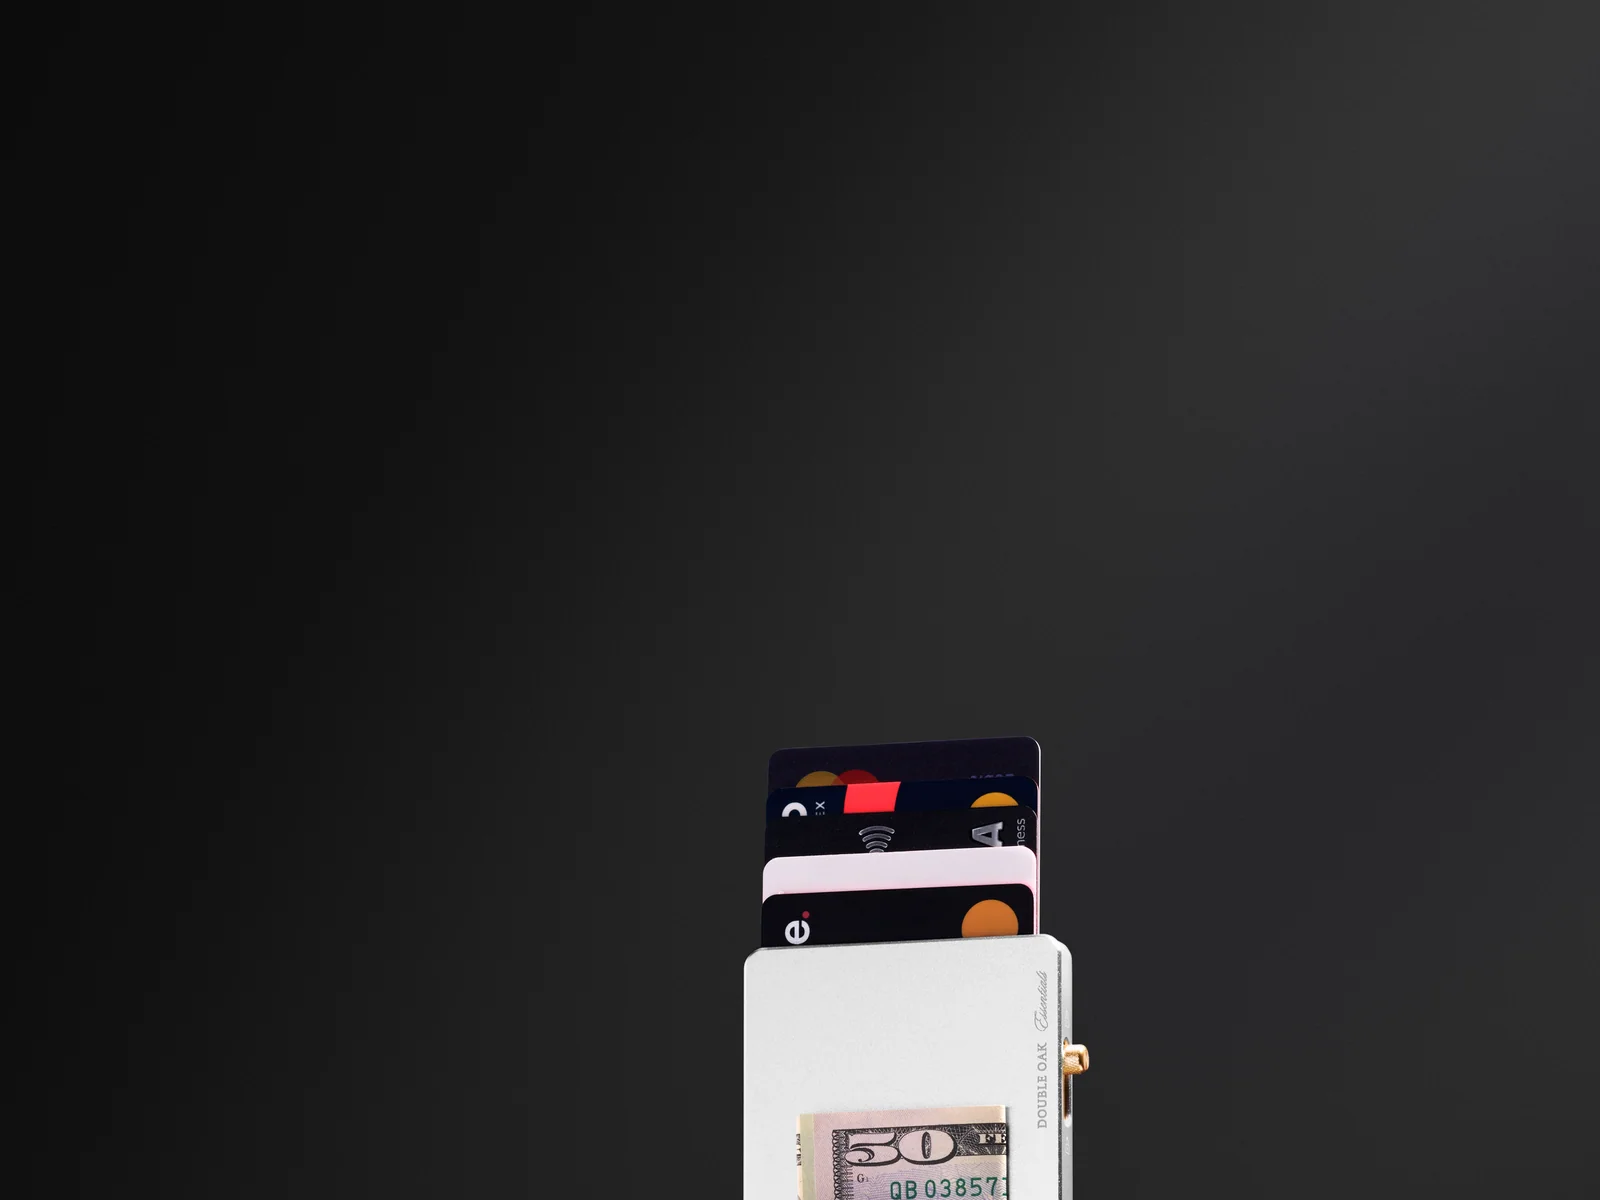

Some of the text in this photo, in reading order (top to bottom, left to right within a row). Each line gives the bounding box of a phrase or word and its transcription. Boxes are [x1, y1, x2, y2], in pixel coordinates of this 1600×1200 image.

[1034, 970, 1049, 1129] DOUBLE OAK Essentials
[845, 1128, 958, 1166] 50
[890, 1180, 917, 1200] QB
